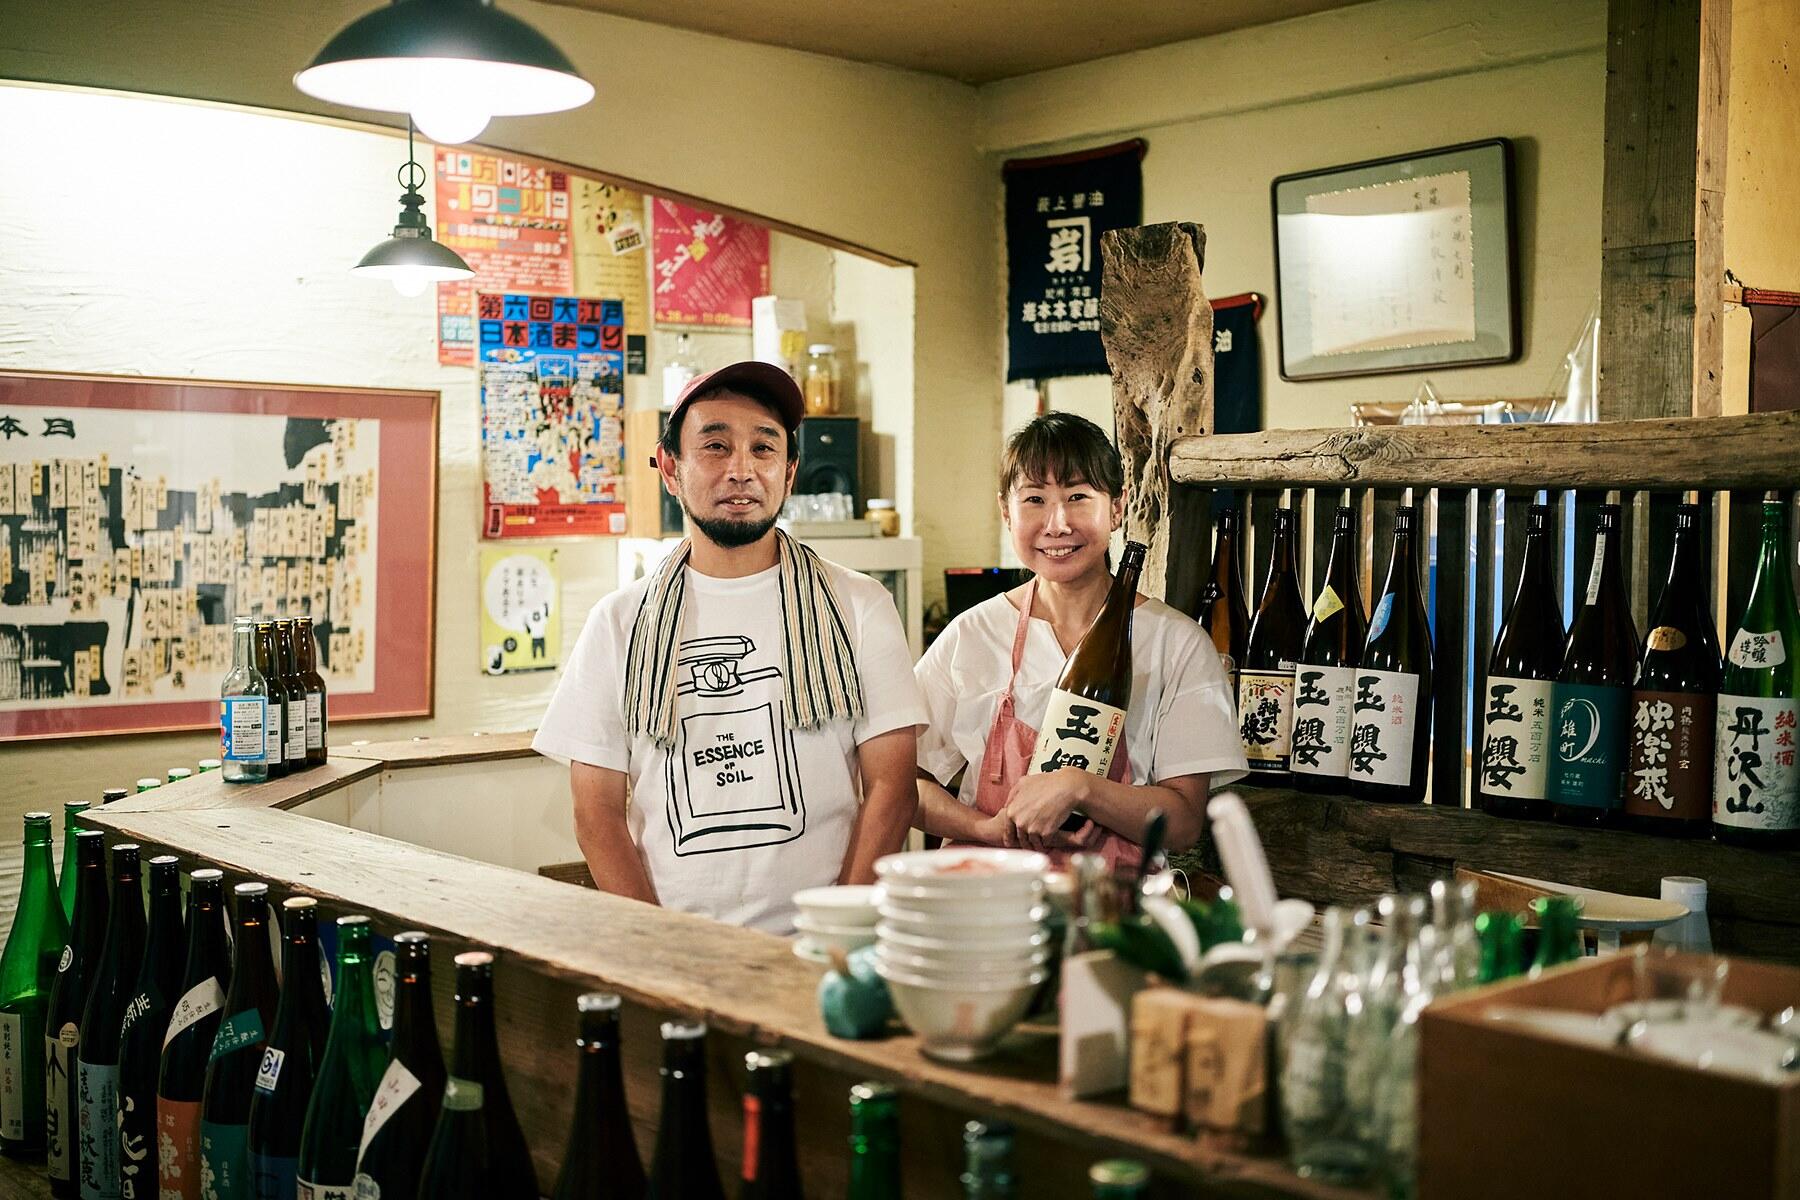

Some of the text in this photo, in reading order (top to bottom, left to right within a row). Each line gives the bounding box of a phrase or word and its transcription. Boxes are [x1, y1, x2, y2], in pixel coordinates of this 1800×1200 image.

[481, 295, 622, 323] 第六回大江戸
[481, 321, 621, 349] 日本酒まつり
[716, 733, 734, 742] THE
[1559, 720, 1576, 757] 雄町
[1774, 710, 1797, 766] 純米酒
[693, 740, 765, 767] ESSENCE
[724, 761, 735, 770] OF
[1633, 700, 1675, 809] 独楽蔵
[716, 770, 754, 787] SOIL
